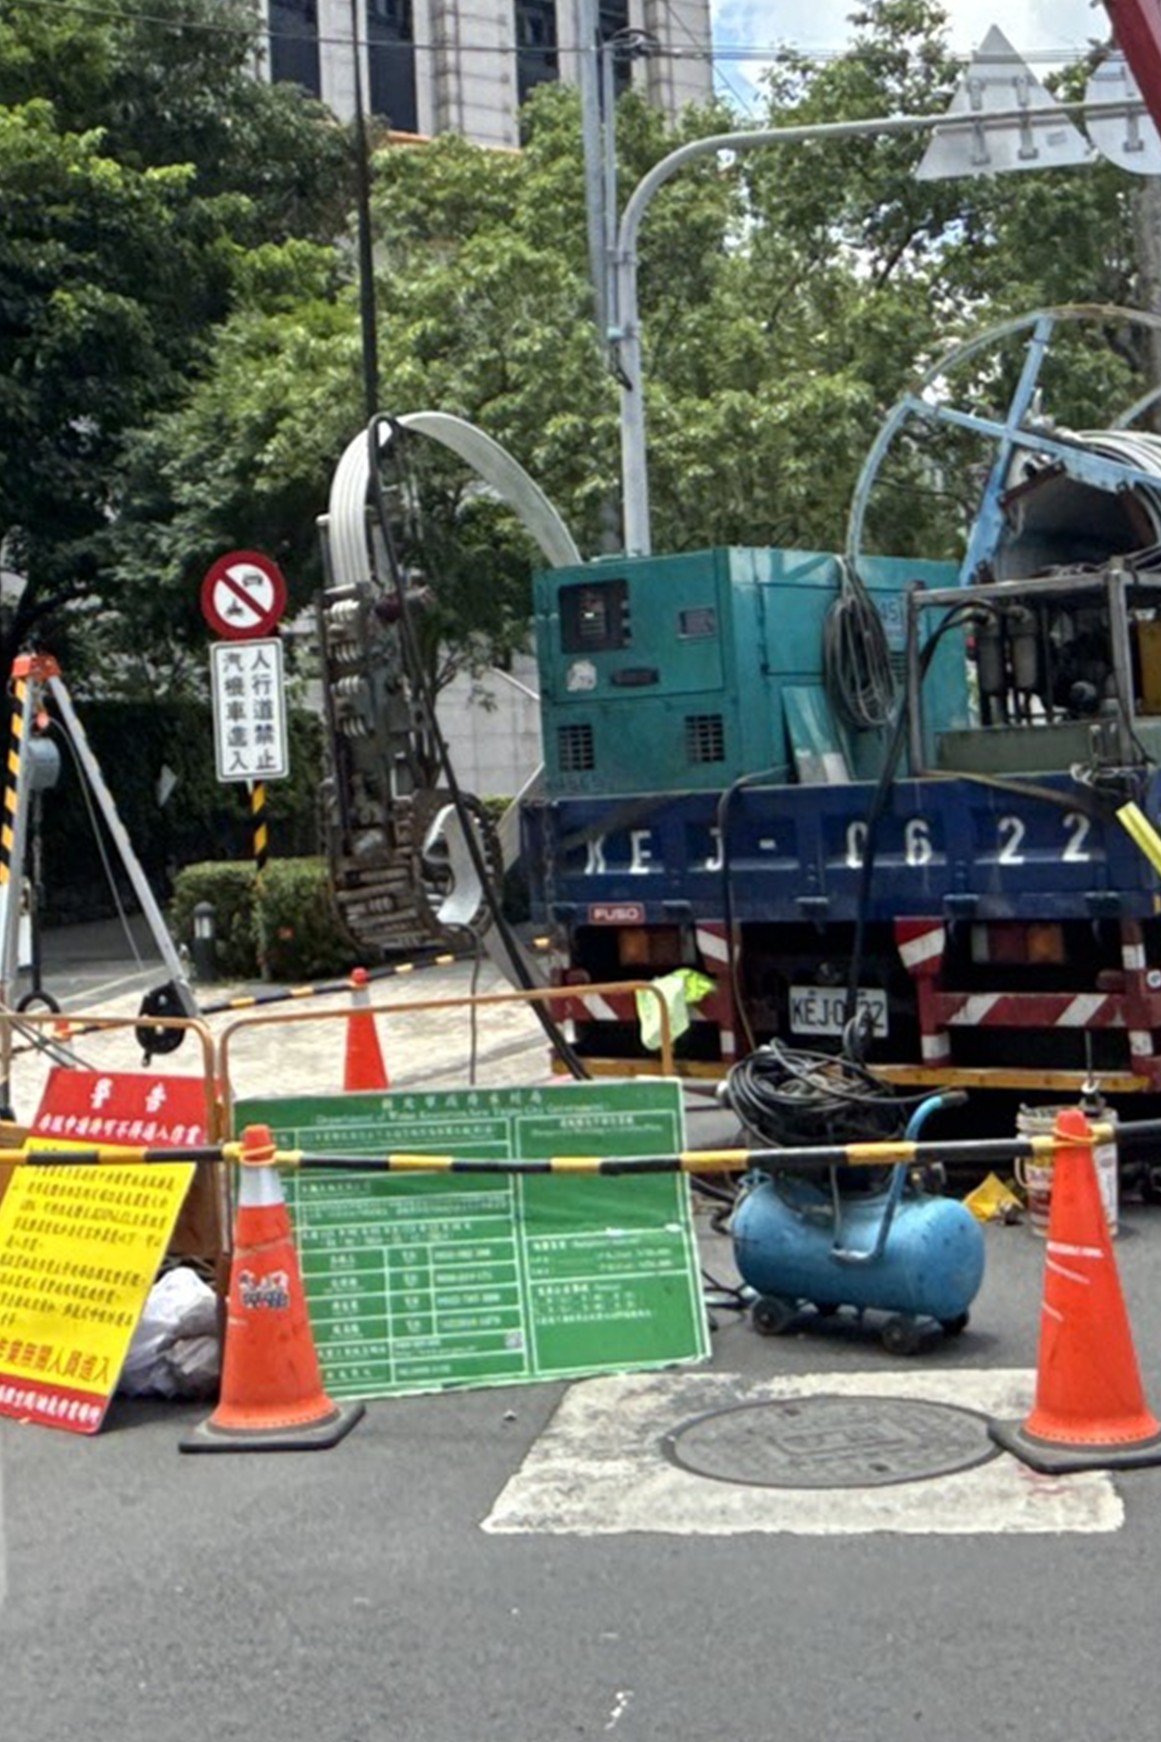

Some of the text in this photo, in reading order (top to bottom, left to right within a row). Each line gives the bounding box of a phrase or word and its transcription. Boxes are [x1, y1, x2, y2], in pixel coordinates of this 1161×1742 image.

[223, 652, 248, 772] 汽機車進入
[251, 650, 276, 770] 人行道禁止
[593, 906, 639, 920] FUSO
